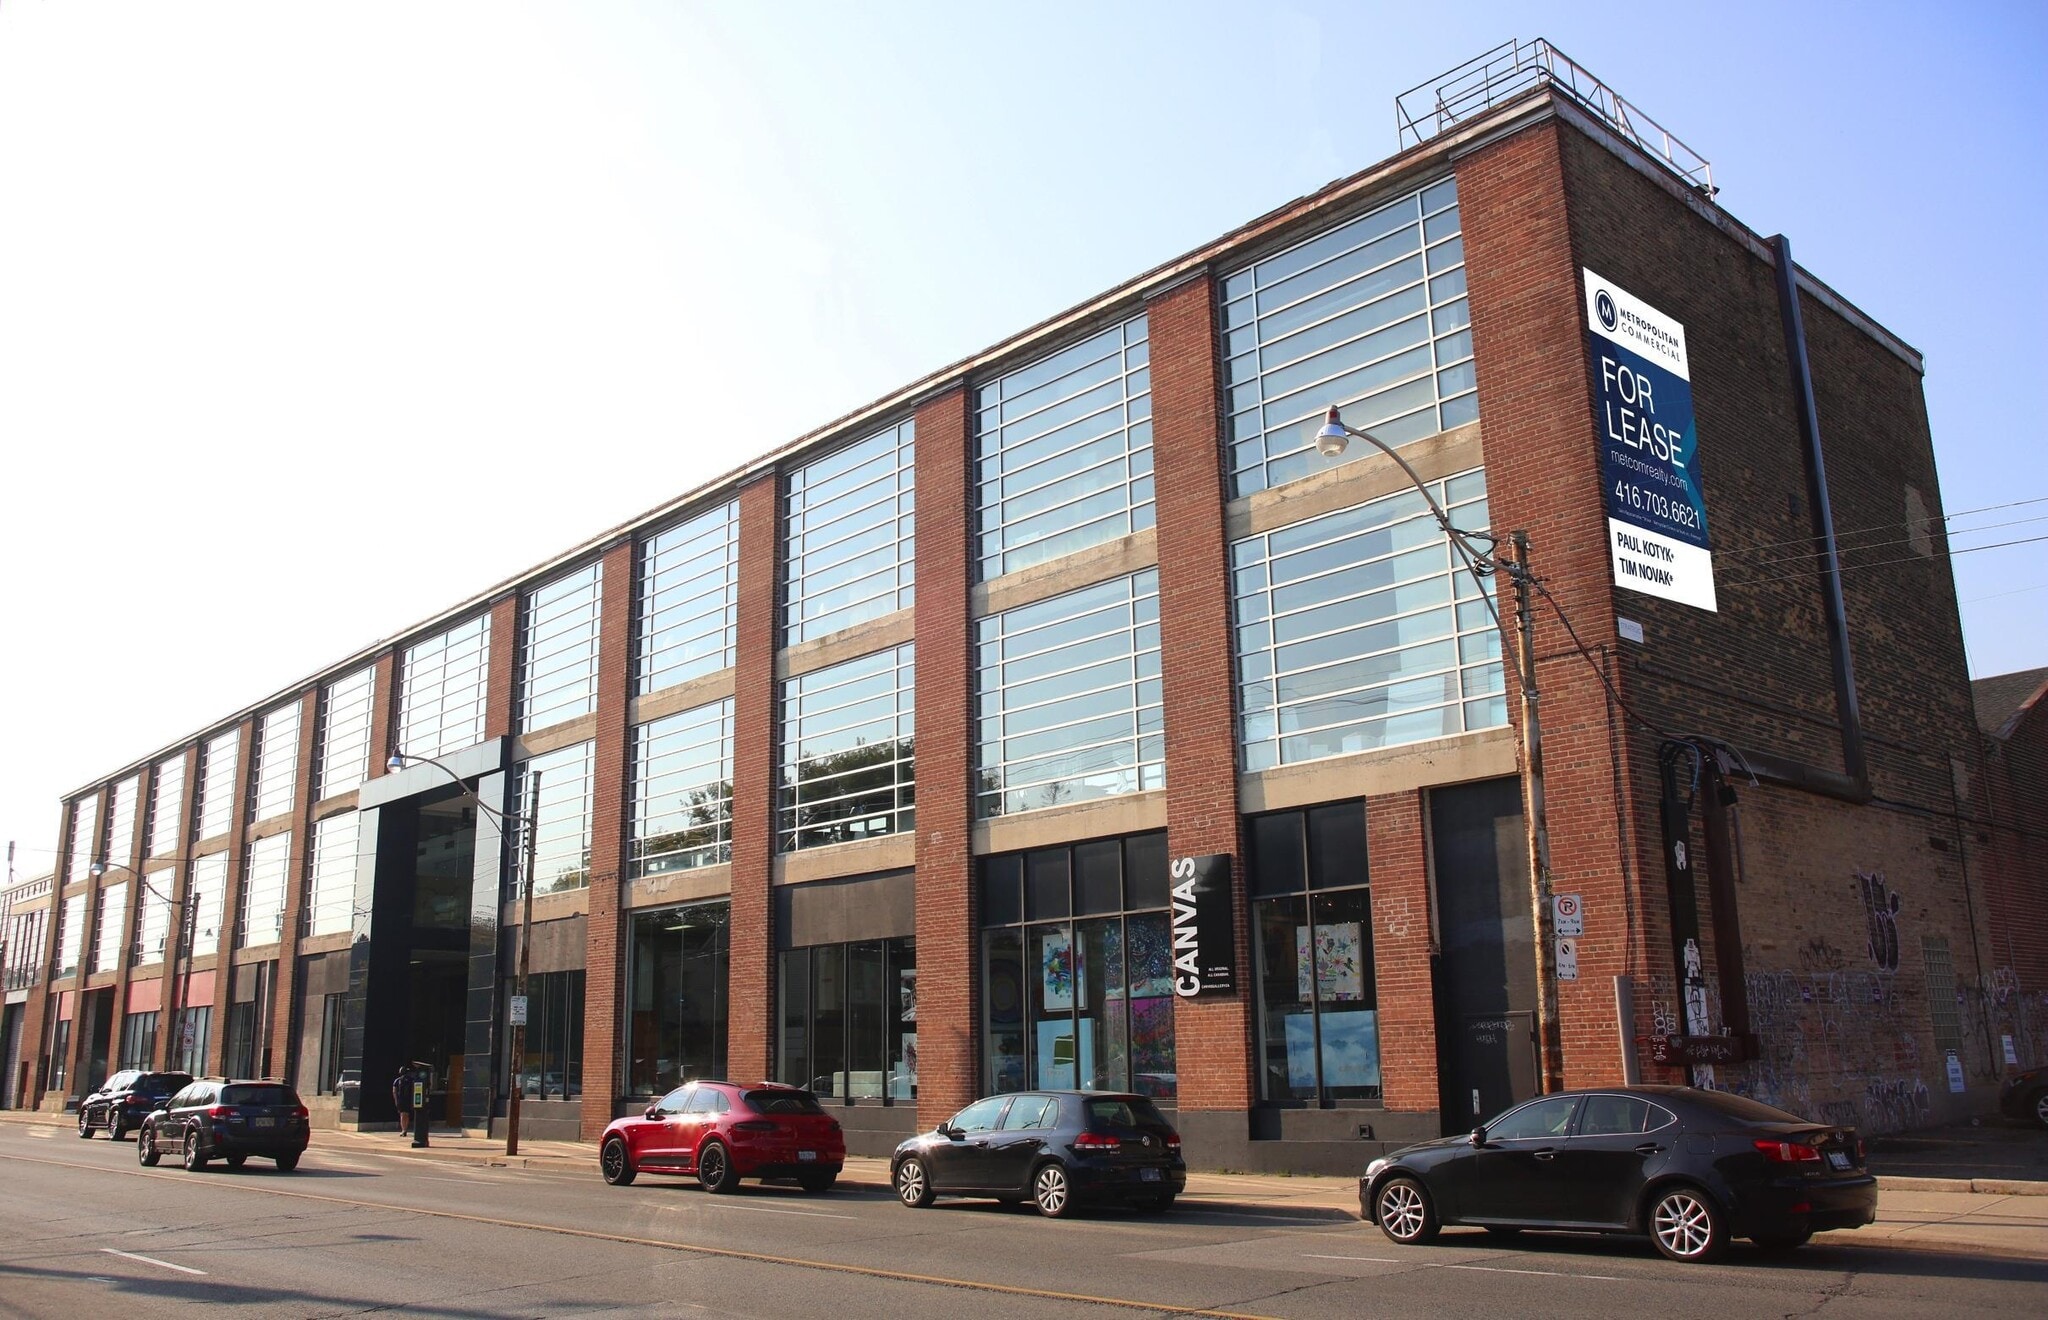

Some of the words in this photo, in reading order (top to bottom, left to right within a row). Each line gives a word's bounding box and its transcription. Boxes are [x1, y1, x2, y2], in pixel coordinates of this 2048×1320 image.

[1620, 308, 1679, 348] METROPOLITAN
[1621, 322, 1680, 362] COMMERCIAL
[1602, 355, 1655, 414] FOR
[1606, 400, 1685, 468] LEASE
[1611, 450, 1689, 491] metcomrealty.com
[1615, 480, 1700, 529] 416.703.6621
[1617, 532, 1642, 553] PAUL
[1619, 557, 1638, 577] TIM
[1171, 857, 1200, 997] CANVAS
